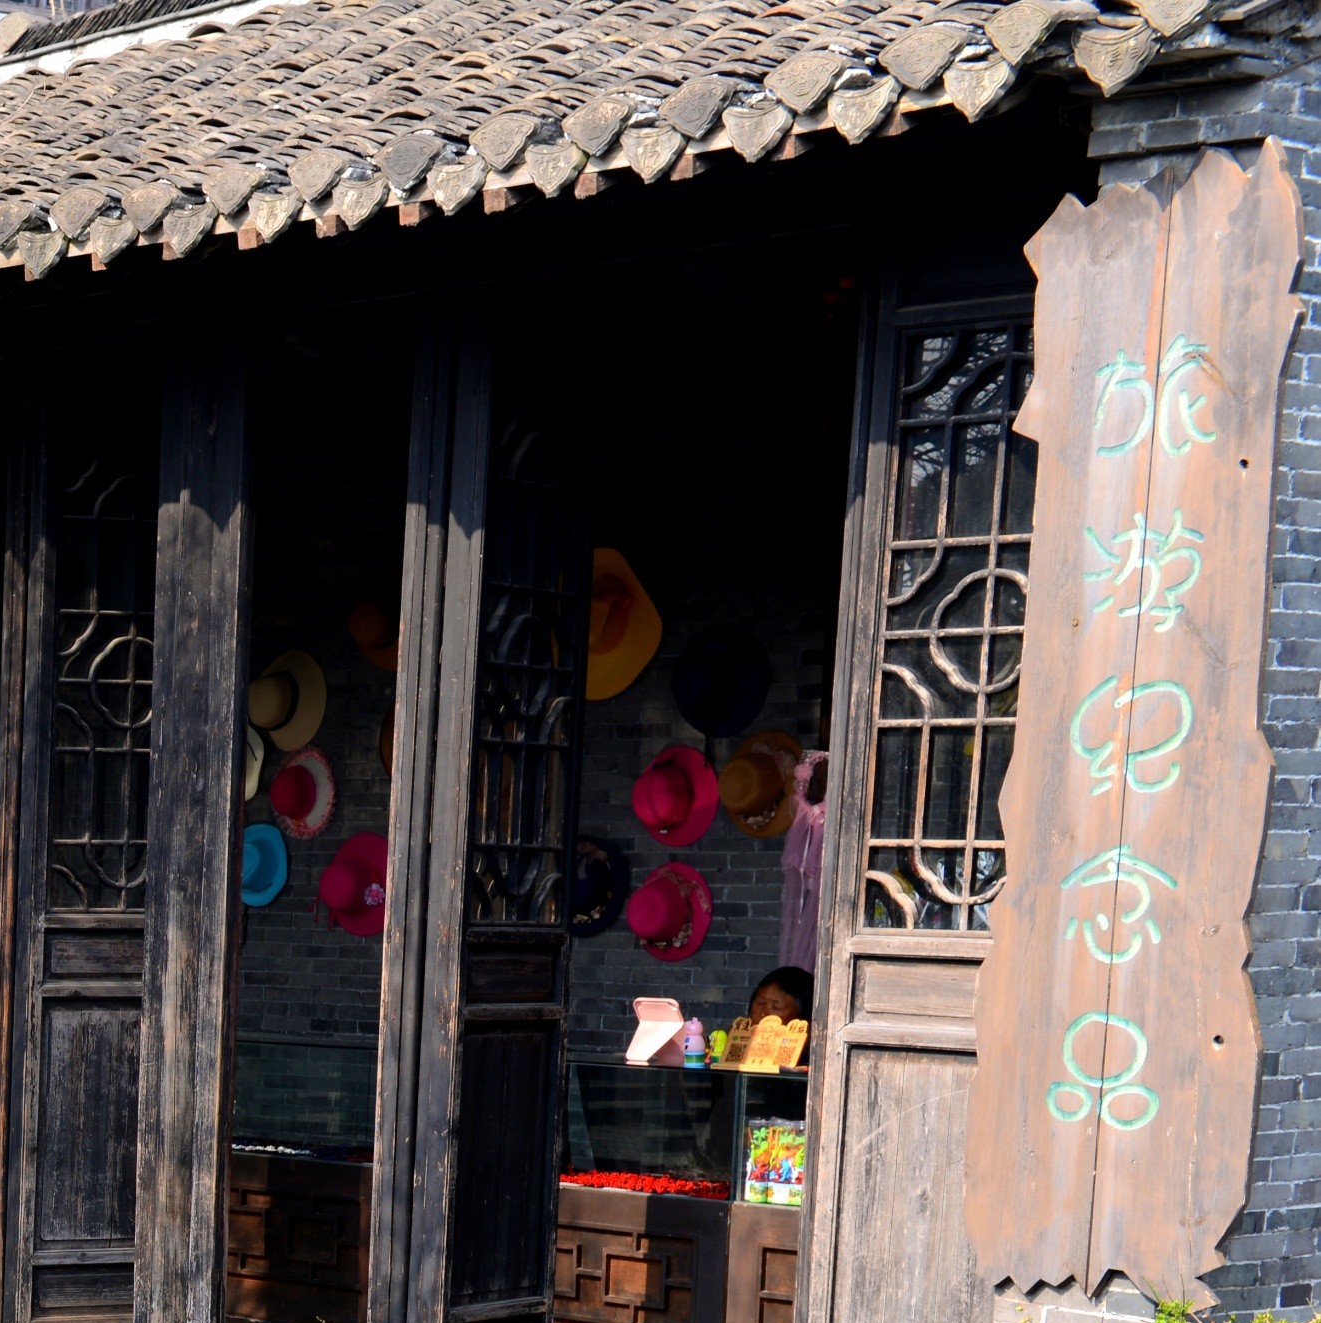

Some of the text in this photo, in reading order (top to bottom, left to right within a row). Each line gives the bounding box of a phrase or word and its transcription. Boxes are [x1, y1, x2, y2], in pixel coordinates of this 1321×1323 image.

[1046, 332, 1217, 1132] 旅游纪念品
